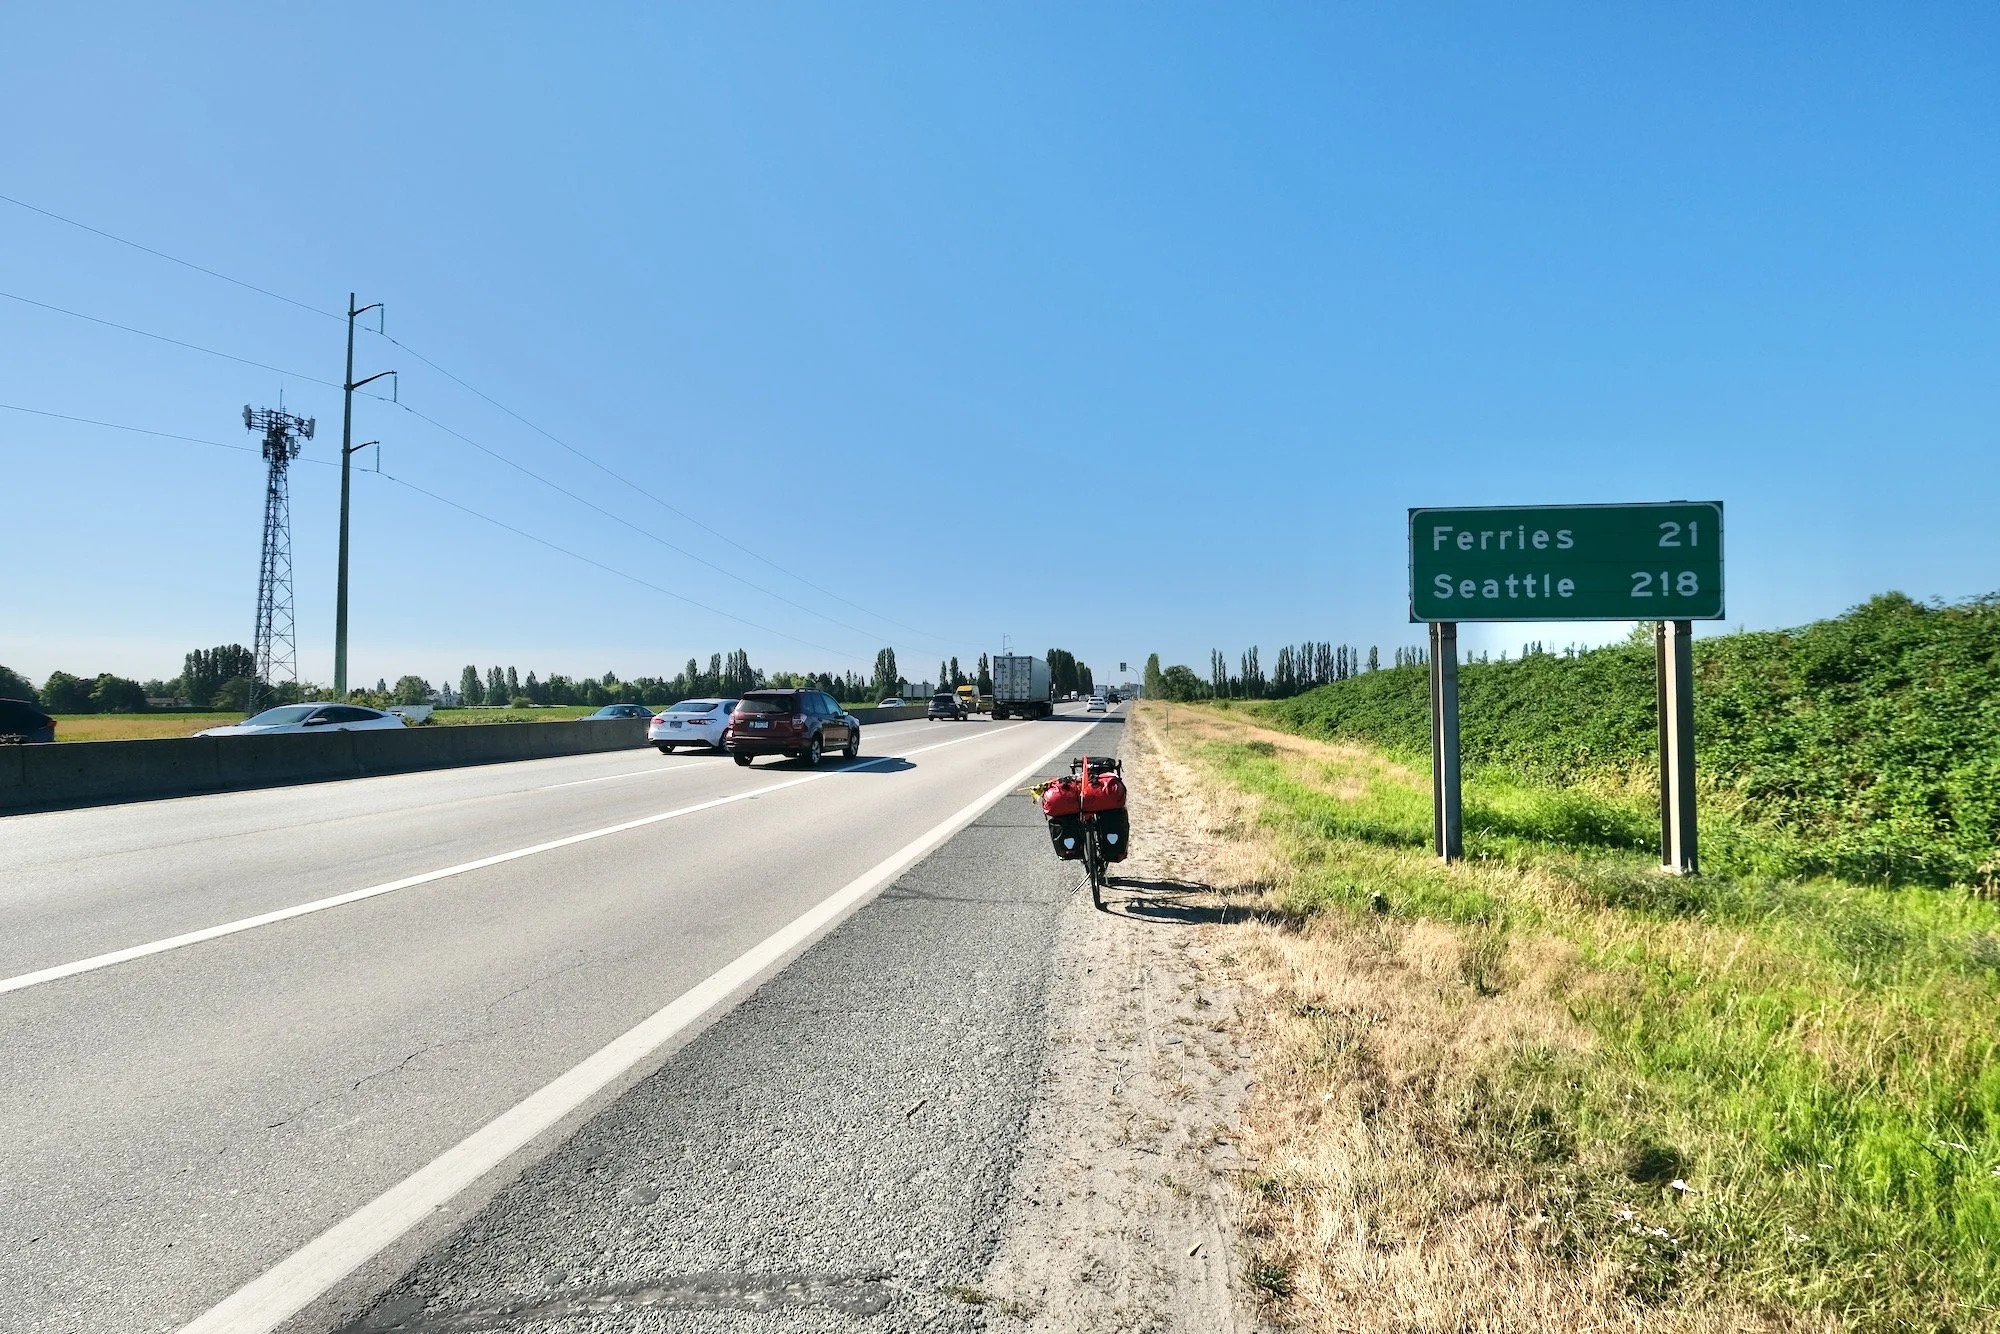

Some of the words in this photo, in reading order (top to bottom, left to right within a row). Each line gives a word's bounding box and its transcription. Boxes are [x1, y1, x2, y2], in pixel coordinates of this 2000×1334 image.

[1433, 525, 1574, 551] Ferries
[1658, 521, 1699, 547] 21
[1433, 573, 1575, 600] Seattle
[1630, 571, 1699, 597] 218
